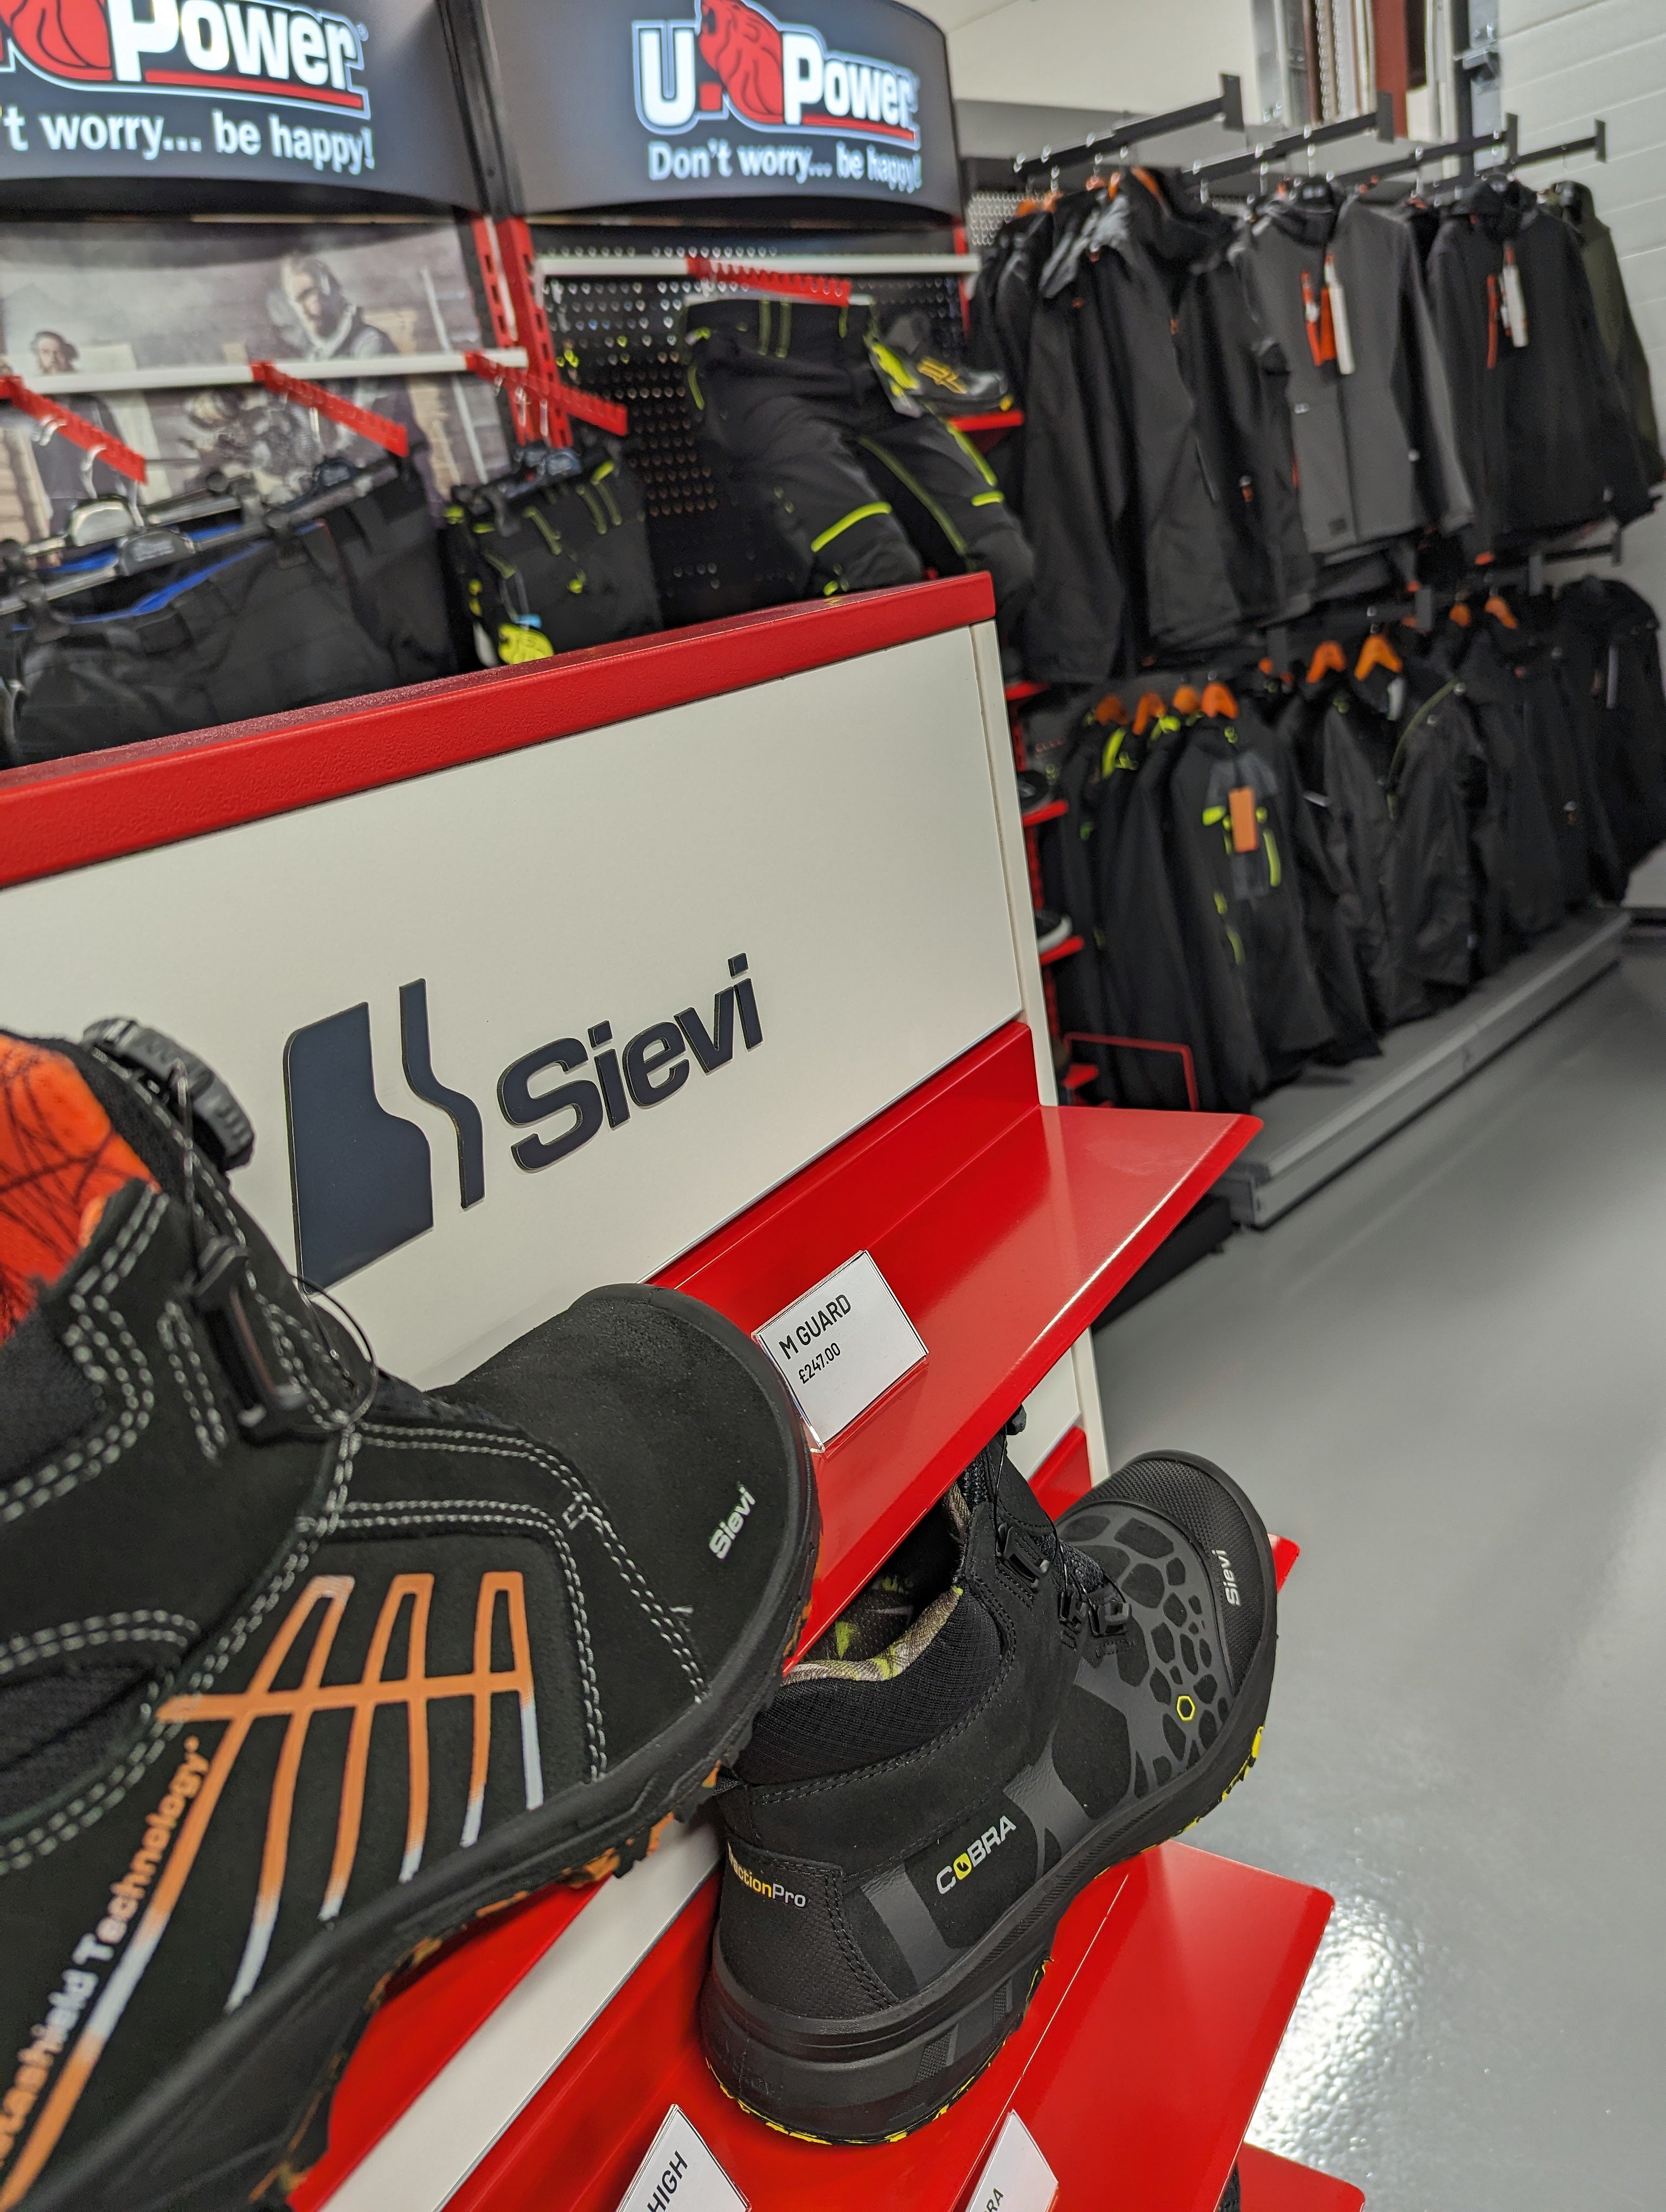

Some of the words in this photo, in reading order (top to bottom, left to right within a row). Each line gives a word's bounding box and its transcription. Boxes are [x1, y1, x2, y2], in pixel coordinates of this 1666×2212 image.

[108, 0, 358, 91] Power
[783, 31, 912, 129] Power
[38, 113, 202, 160] worry...
[213, 110, 261, 155] be
[270, 115, 375, 175] happy!
[649, 139, 731, 181] Don't
[738, 145, 833, 184] worry...
[836, 141, 865, 180] be
[867, 144, 922, 194] happy!
[497, 953, 764, 1172] Sievi
[778, 1334, 799, 1360] M
[796, 1294, 852, 1346] GUARD
[798, 1342, 841, 1385] £247.00
[709, 1483, 756, 1559] Sievi
[1211, 1549, 1241, 1607] Sievi
[72, 1747, 210, 1965] Technology
[936, 1815, 1017, 1894] COBRA
[647, 2150, 688, 2212] HIGH
[984, 2188, 1004, 2212] RA
